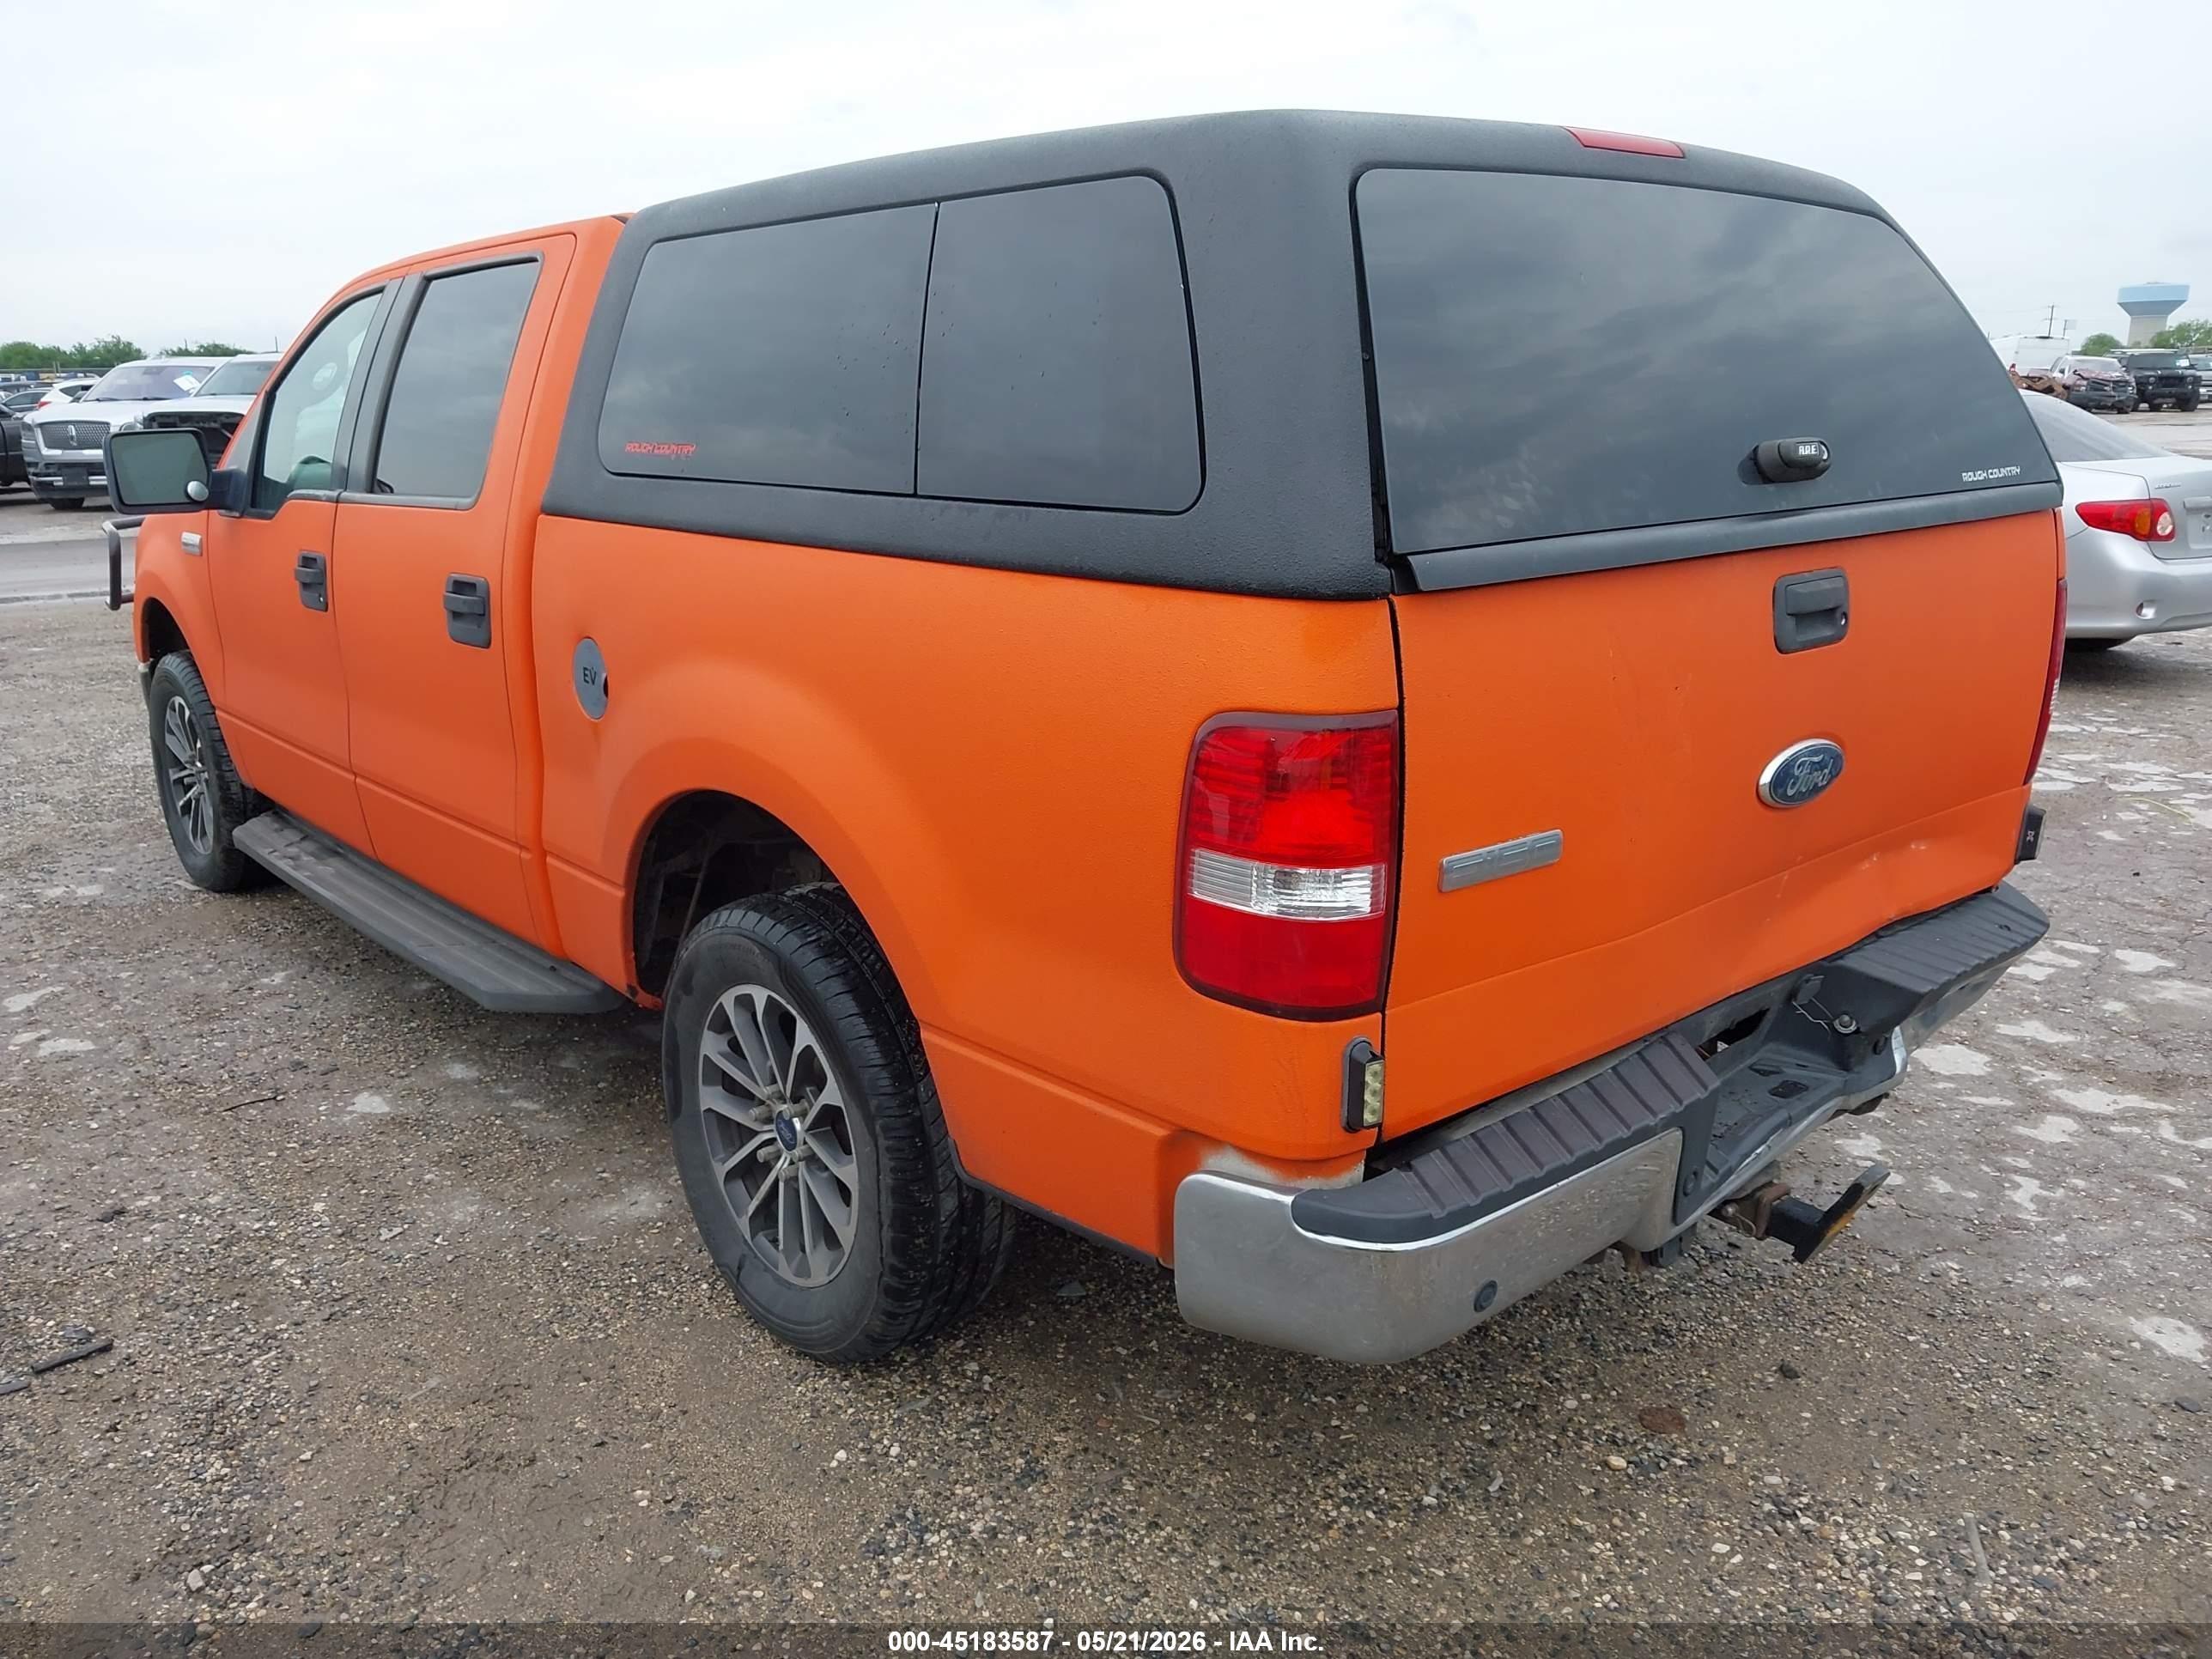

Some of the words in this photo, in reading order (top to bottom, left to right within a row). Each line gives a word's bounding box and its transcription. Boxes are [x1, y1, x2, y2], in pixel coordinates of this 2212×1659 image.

[624, 442, 653, 454] ROUGH
[653, 442, 696, 456] COUNTRY
[1961, 470, 1988, 482] ROUGH
[1988, 465, 2021, 479] COUNTRY
[583, 666, 597, 686] EV
[1786, 754, 1834, 797] Ford
